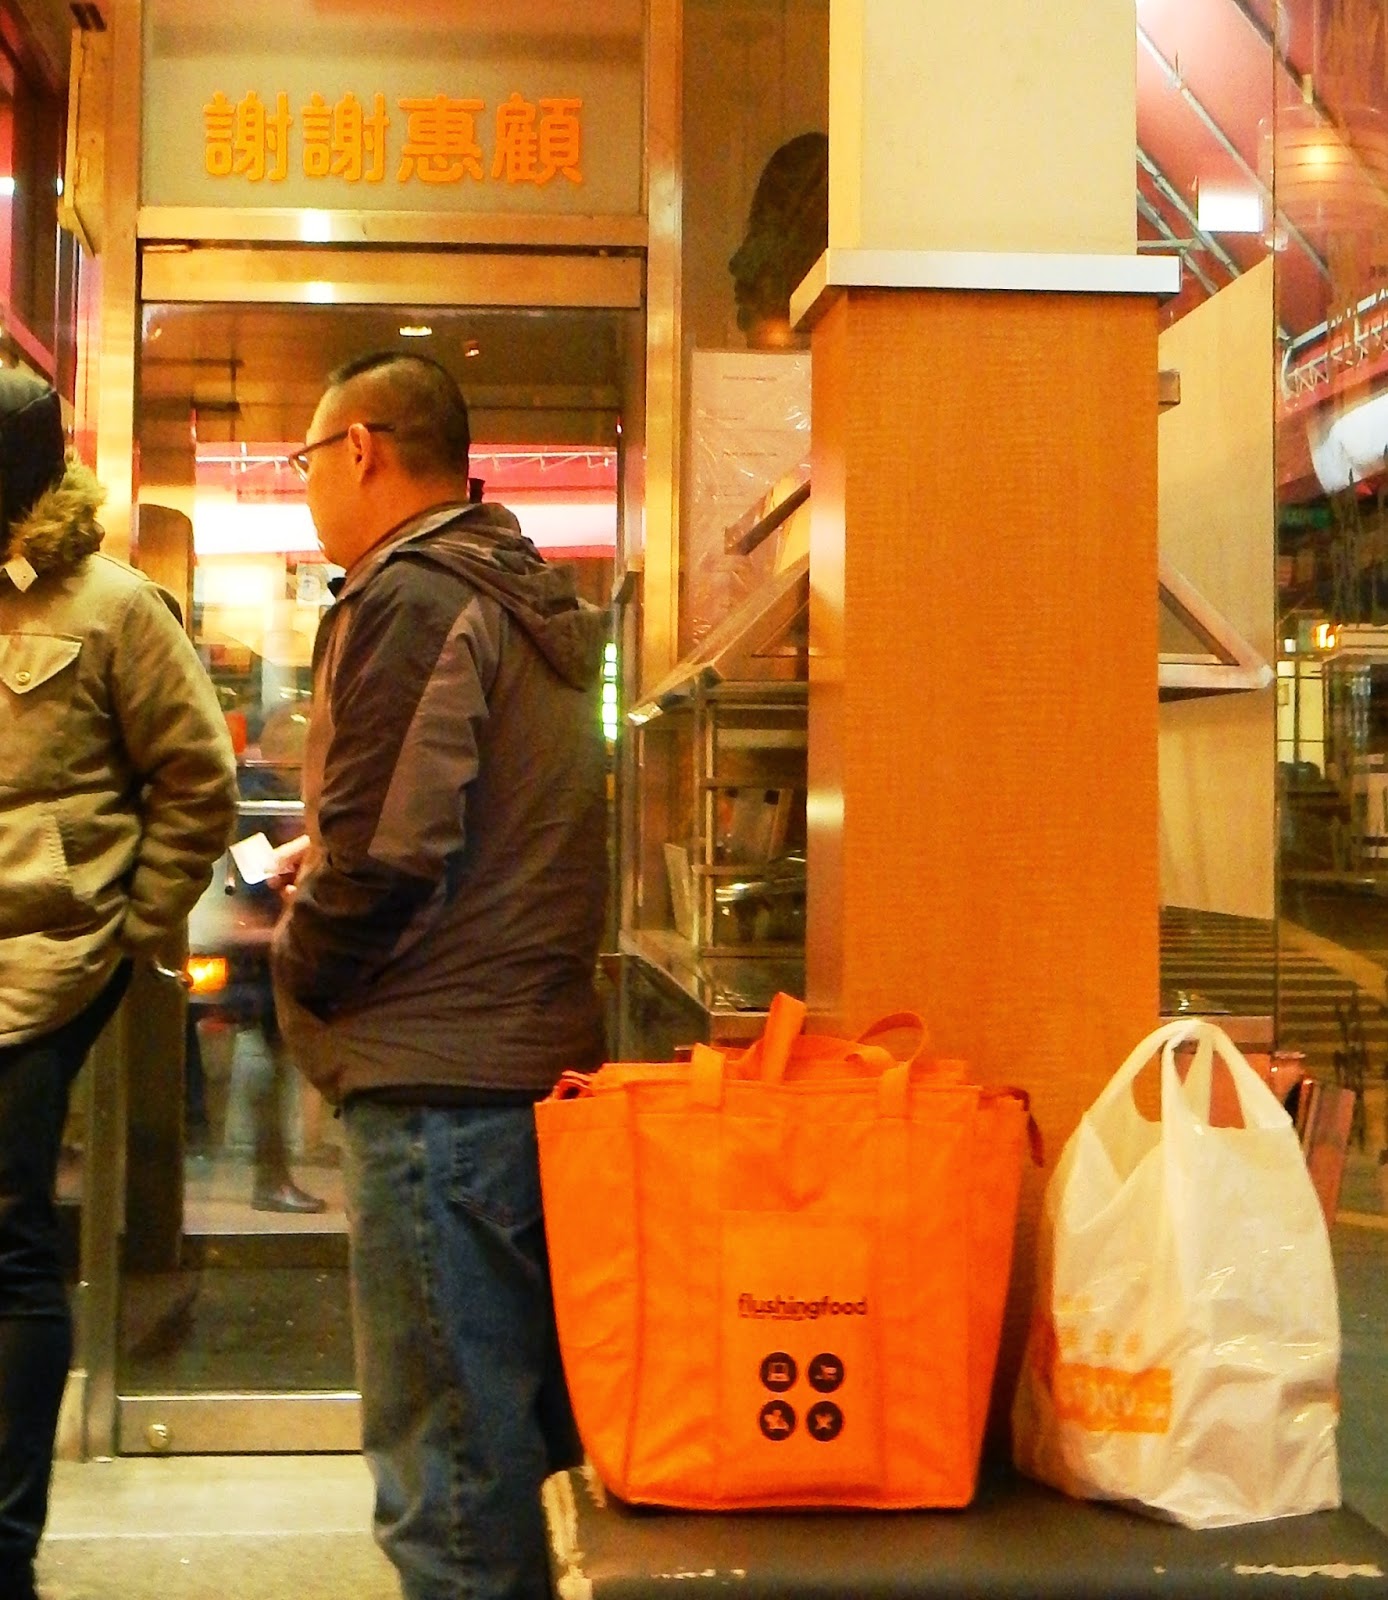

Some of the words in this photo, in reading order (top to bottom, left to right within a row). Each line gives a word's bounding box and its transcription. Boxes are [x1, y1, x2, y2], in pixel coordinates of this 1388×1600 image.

[203, 90, 584, 185] 謝謝惠顧
[738, 1293, 868, 1319] flushingfood
